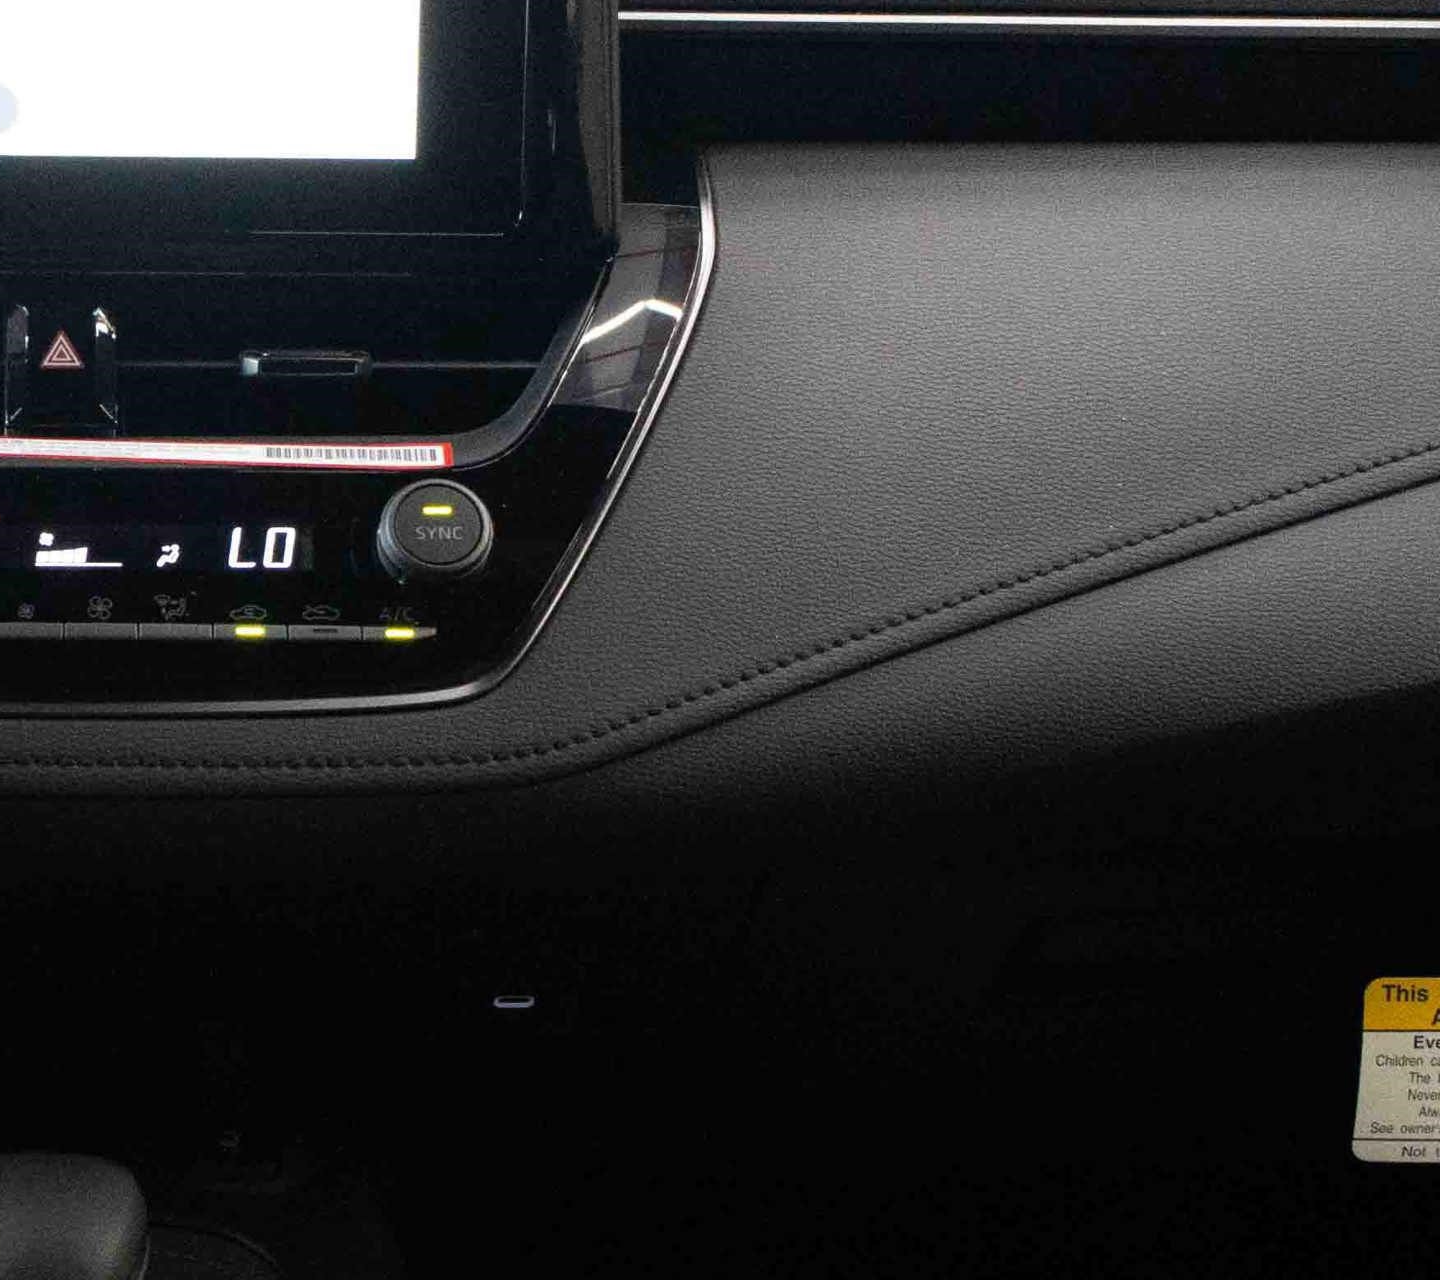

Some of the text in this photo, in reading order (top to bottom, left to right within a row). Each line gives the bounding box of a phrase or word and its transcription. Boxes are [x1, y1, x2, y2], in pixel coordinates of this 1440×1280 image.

[416, 525, 464, 541] SYNC
[229, 526, 297, 569] LO
[1382, 984, 1429, 1003] This
[1375, 1054, 1424, 1068] Children
[1409, 1071, 1432, 1084] The
[1369, 1122, 1394, 1135] See
[1401, 1145, 1427, 1158] Not
